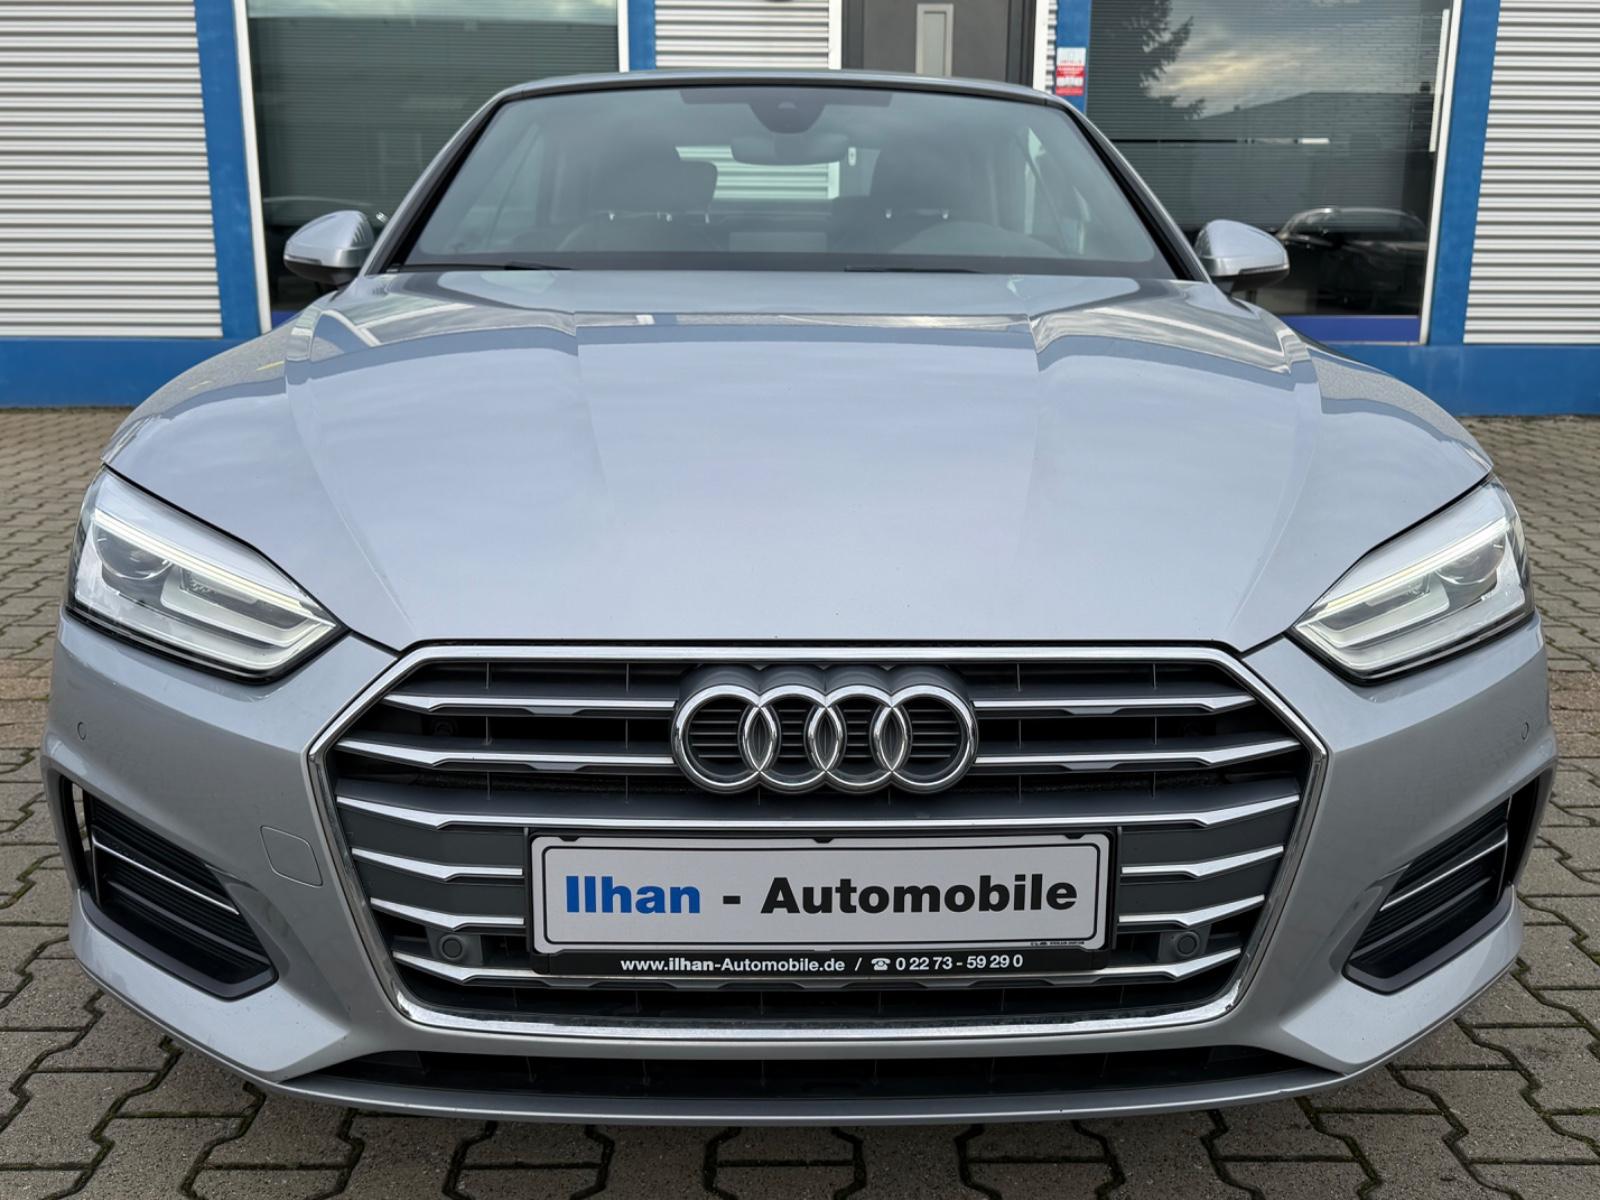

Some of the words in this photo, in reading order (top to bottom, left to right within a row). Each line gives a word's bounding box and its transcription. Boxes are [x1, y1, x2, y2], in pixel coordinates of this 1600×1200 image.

[566, 875, 700, 914] Ilhan
[760, 873, 1077, 914] Automobile
[620, 957, 845, 972] www.ilhan-Automobile.de
